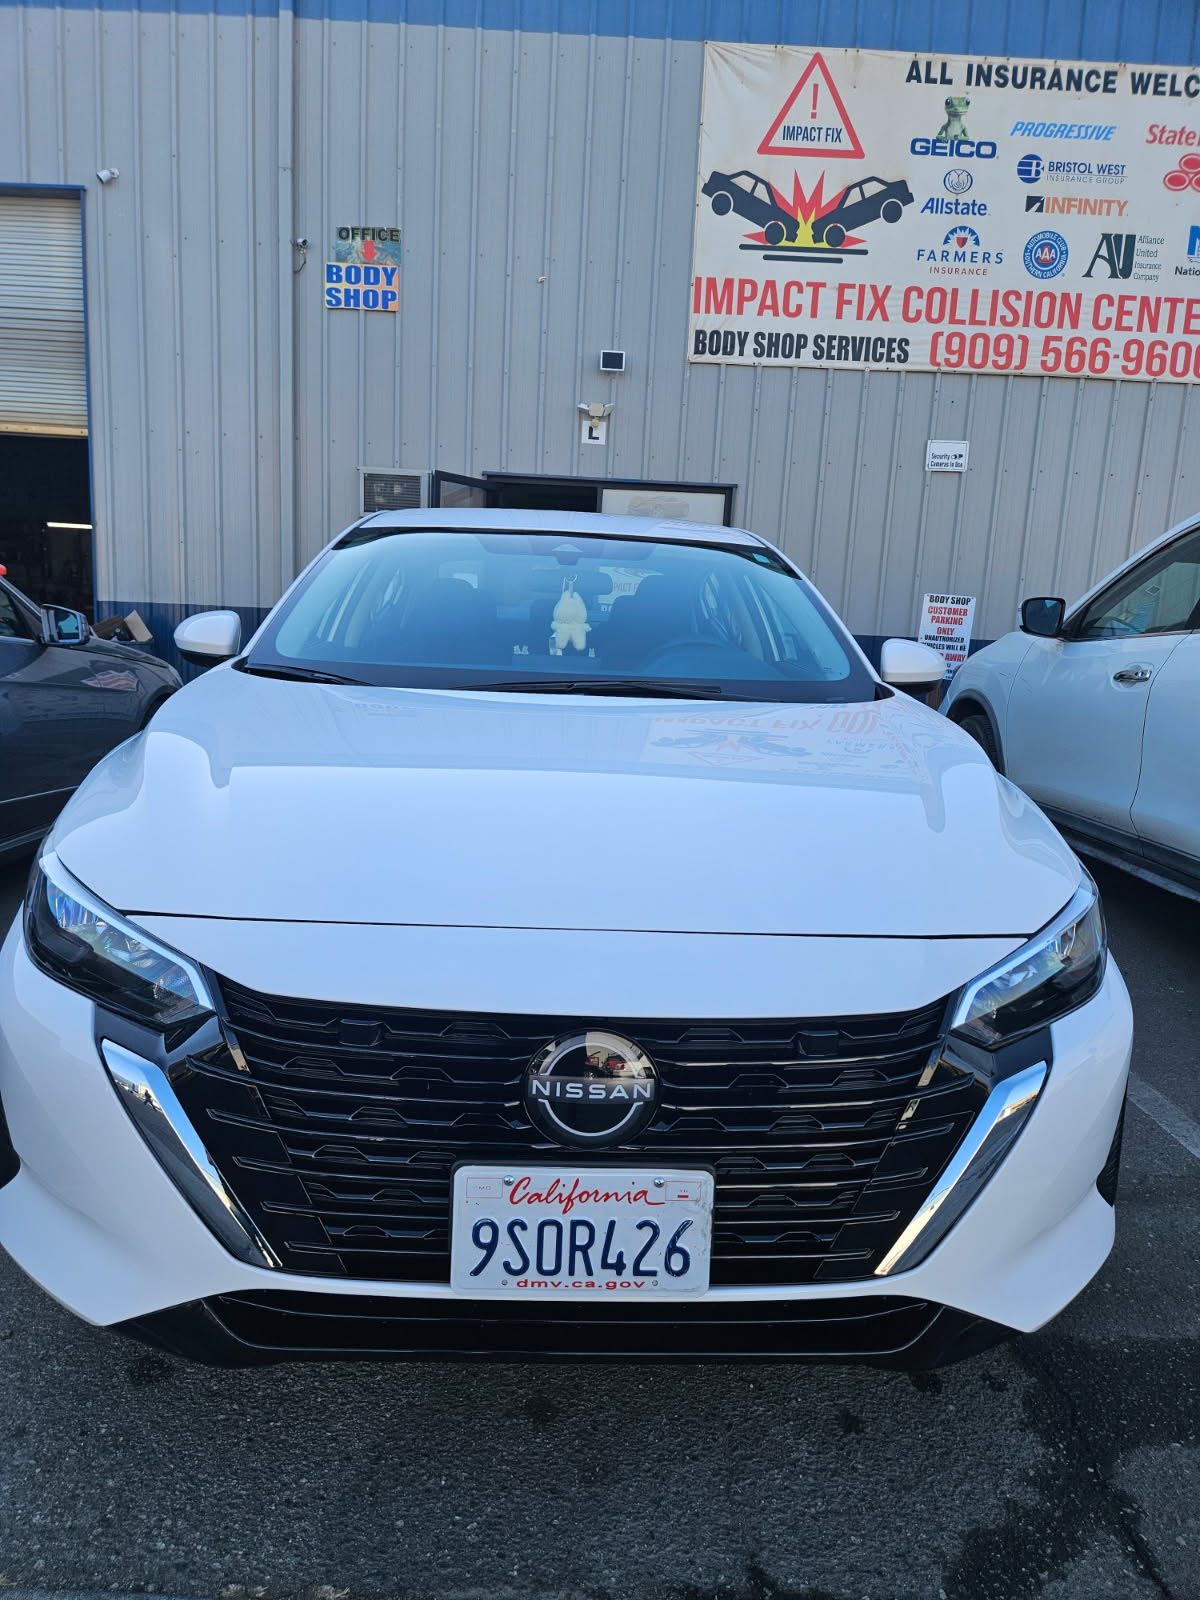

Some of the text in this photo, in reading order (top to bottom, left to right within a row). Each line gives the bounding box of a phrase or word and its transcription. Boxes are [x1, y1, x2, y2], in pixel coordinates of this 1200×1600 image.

[905, 60, 953, 85] ALL
[966, 63, 1118, 93] INSURANCE
[782, 125, 843, 143] IMPACT FIX
[1010, 121, 1117, 141] PROGRESSIVE
[910, 138, 997, 159] GEICO
[1048, 161, 1126, 175] BRISTOL WEST
[1046, 174, 1125, 185] INSURANCE GROUP
[920, 198, 987, 216] Allstate
[1045, 196, 1128, 216] INFINITY
[338, 227, 400, 242] OFFICE
[1026, 231, 1067, 251] AUTOMOBILE CLUB
[1137, 235, 1165, 245] Alliance
[916, 248, 1004, 264] FARMERS
[1035, 247, 1056, 260] AAA
[1135, 248, 1158, 258] United
[929, 266, 989, 276] INSURANCE
[1134, 261, 1162, 270] Insurance
[326, 264, 397, 286] BODY
[1133, 273, 1160, 283] Company
[325, 287, 397, 310] SHOP
[693, 276, 827, 319] IMPACT
[835, 283, 893, 322] FIX
[902, 286, 1083, 330] COLLISION
[694, 329, 910, 364] BODY SHOP SERVICES
[929, 331, 1030, 370] (909)
[588, 426, 600, 440] L
[929, 595, 971, 606] BODY SHOP
[927, 606, 968, 616] CUSTOMER
[931, 616, 963, 626] PARKING
[936, 626, 955, 636] ONLY
[924, 634, 964, 643] UNAUTHORIZED
[944, 653, 966, 662] AWAY
[531, 1079, 651, 1100] NISSAN
[508, 1176, 666, 1215] California
[516, 1279, 646, 1290] dmv.ca.gov
